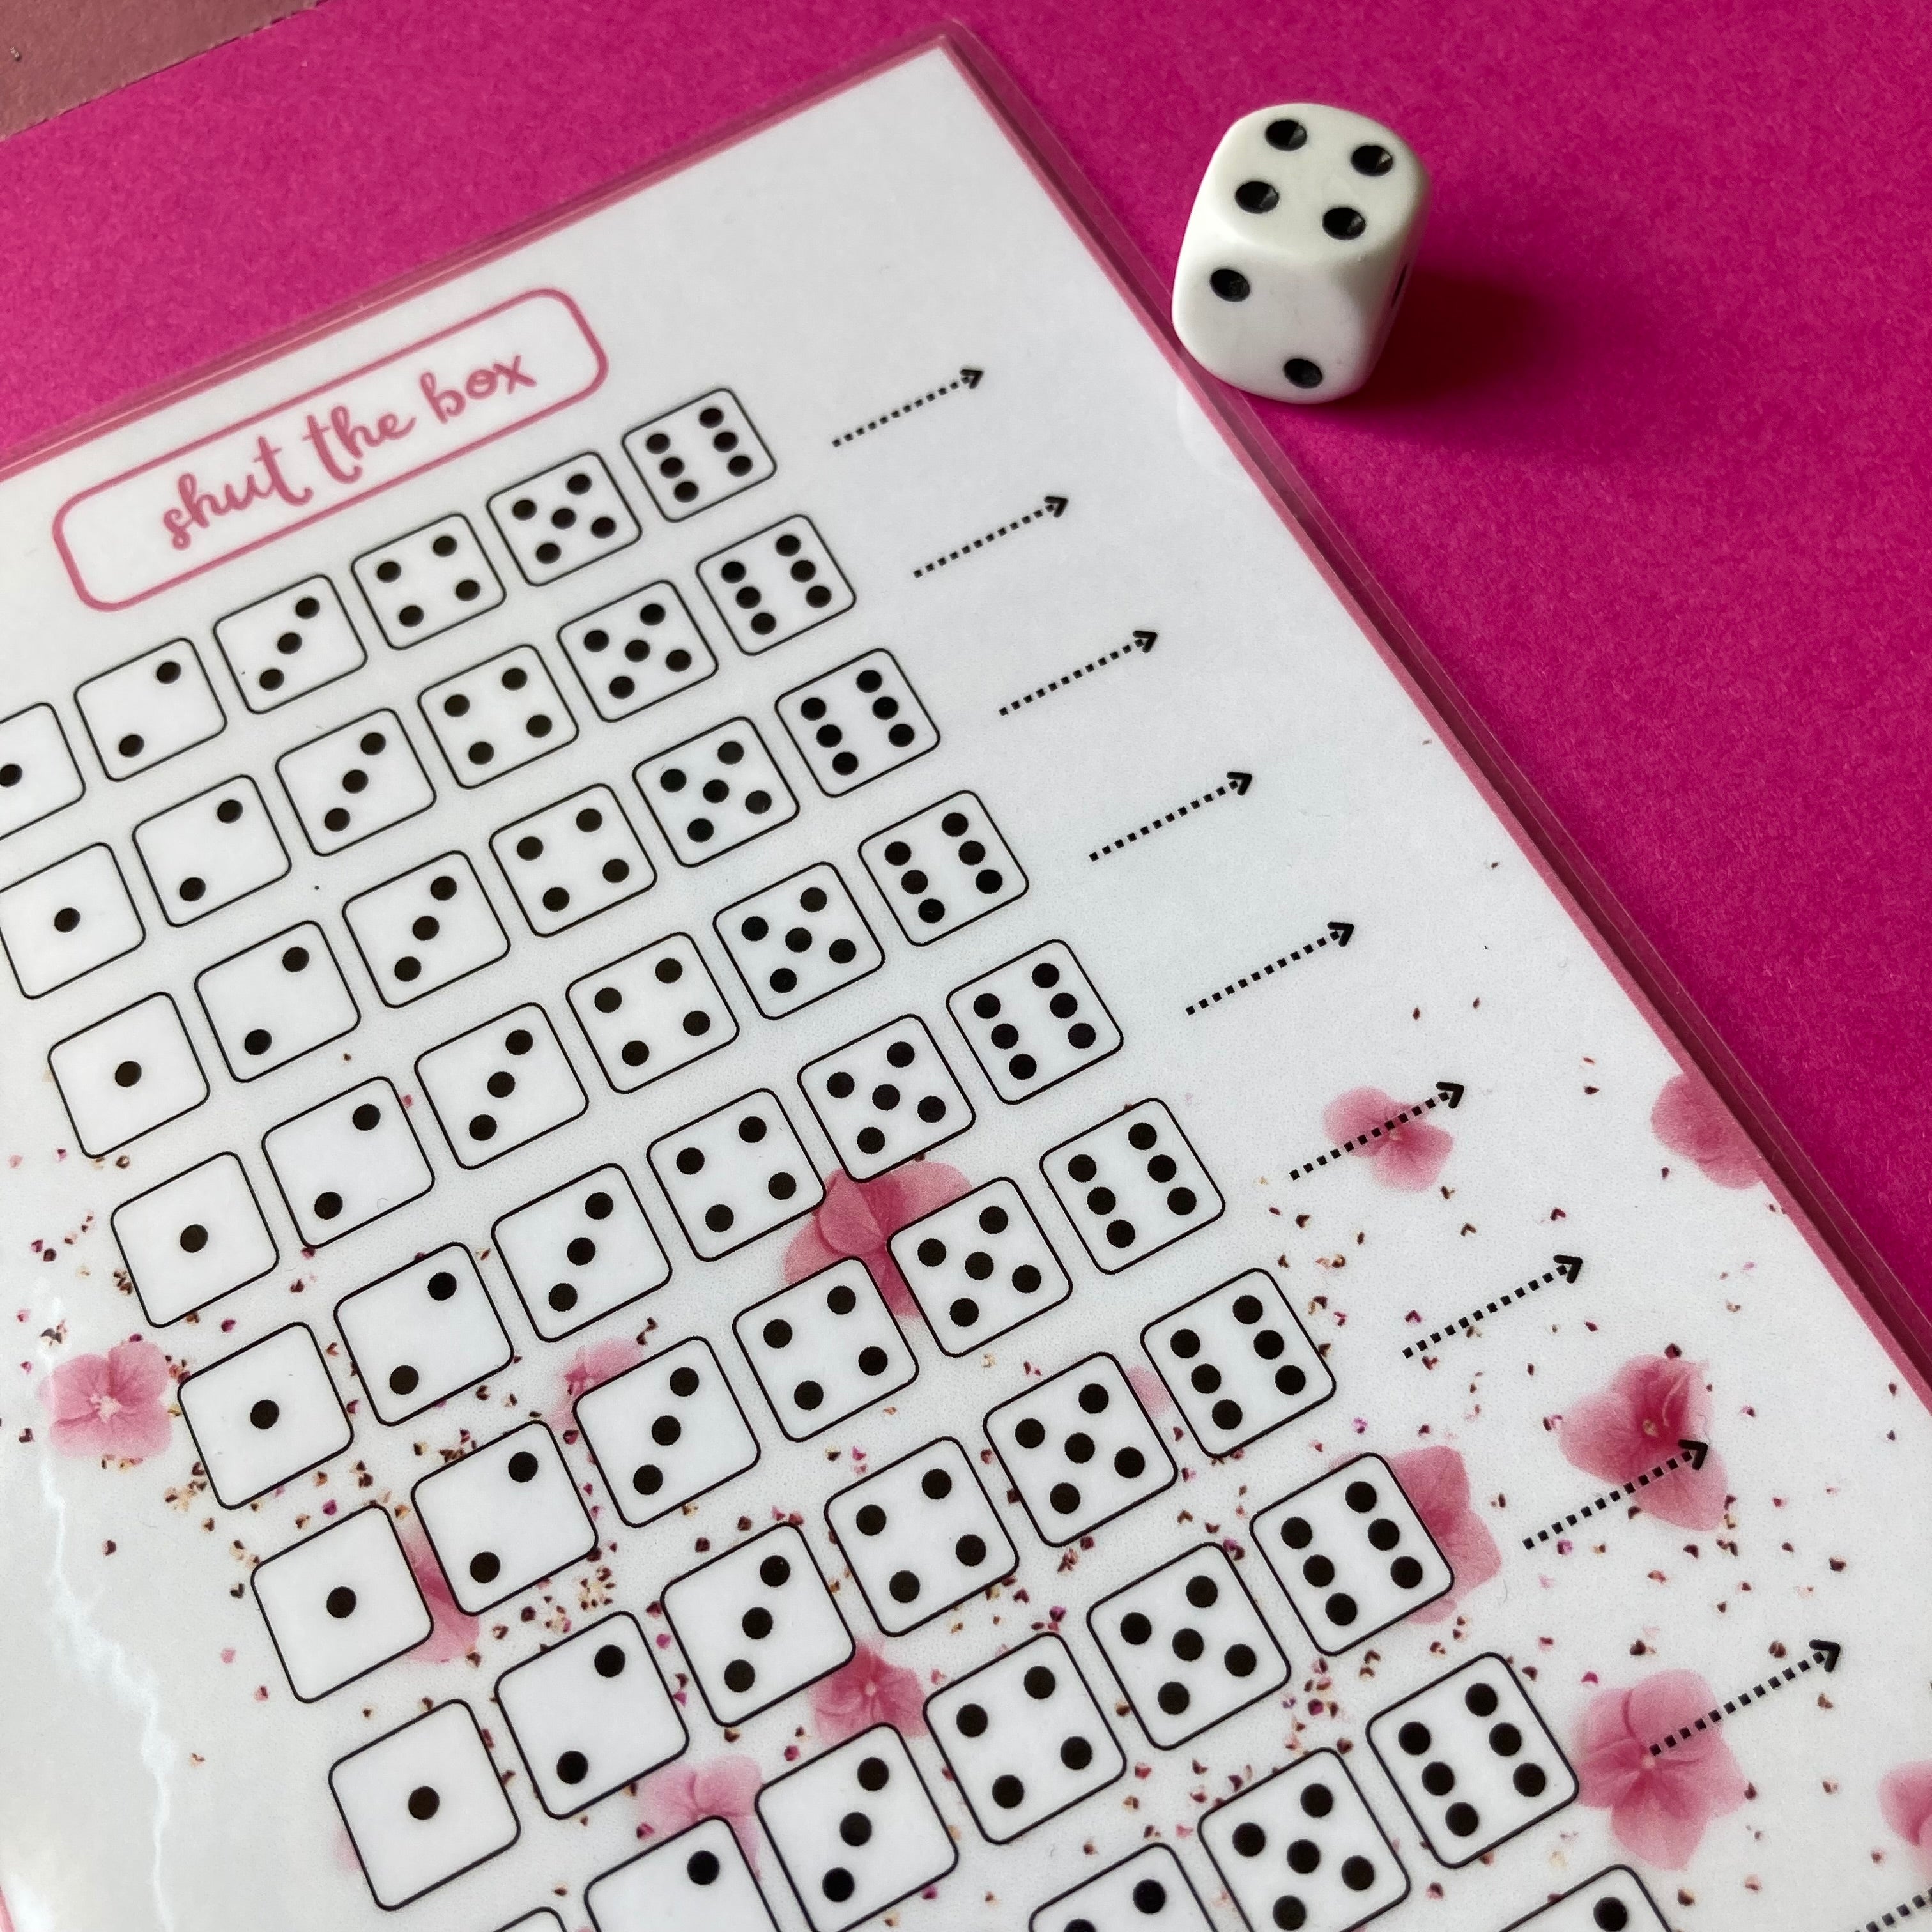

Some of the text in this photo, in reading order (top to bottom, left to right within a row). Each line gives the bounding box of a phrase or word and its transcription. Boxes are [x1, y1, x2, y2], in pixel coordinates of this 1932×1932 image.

[162, 355, 537, 550] shut the box
